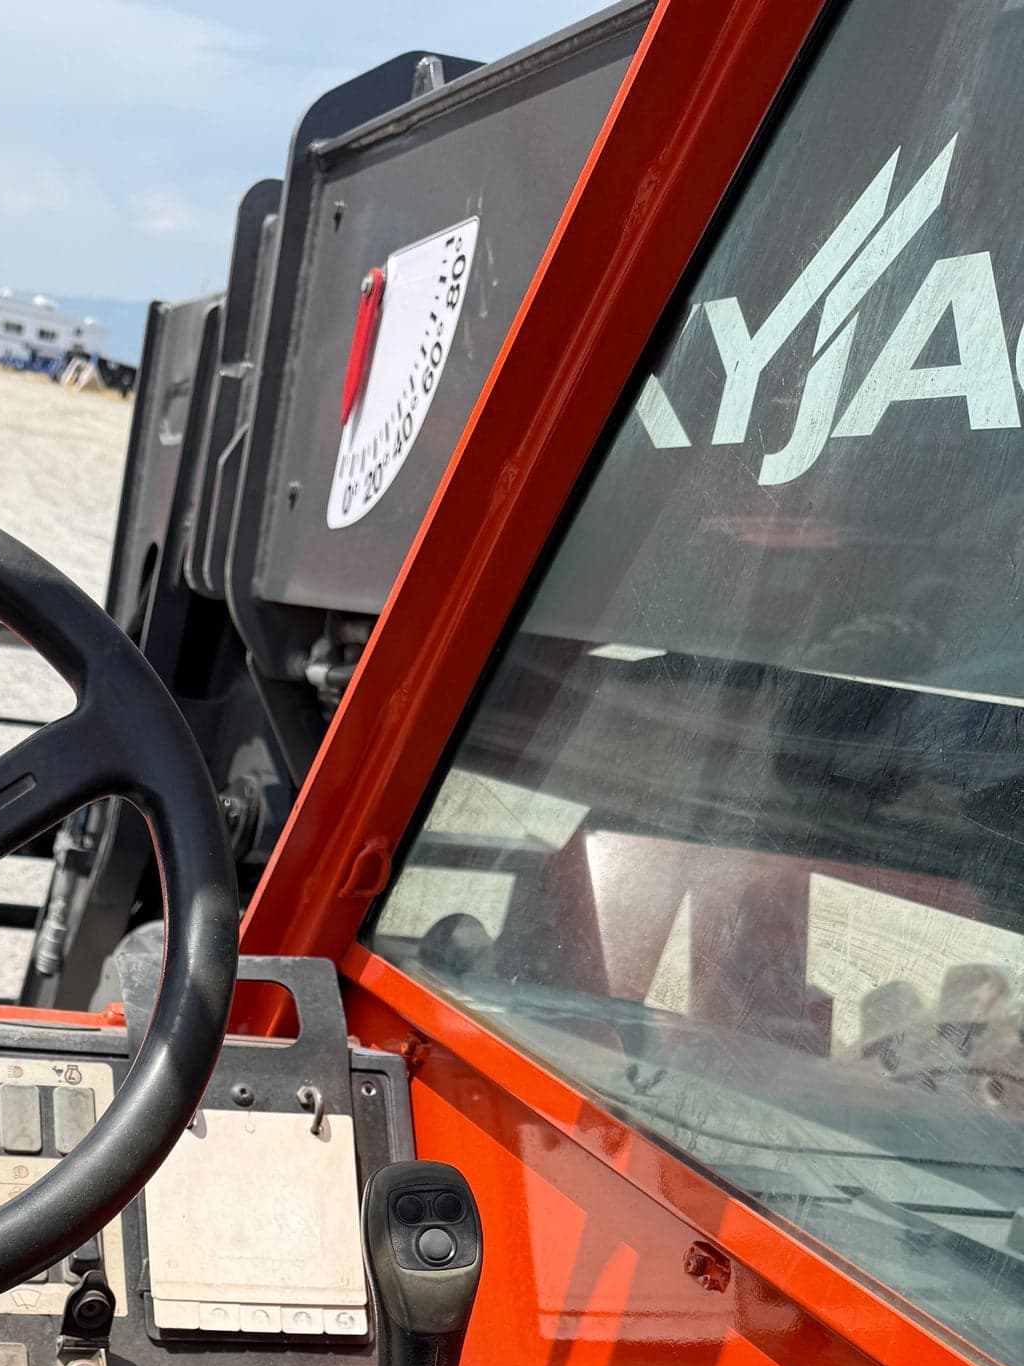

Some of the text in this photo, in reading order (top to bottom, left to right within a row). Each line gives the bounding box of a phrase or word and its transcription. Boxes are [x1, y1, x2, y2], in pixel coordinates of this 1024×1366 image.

[422, 321, 444, 394] 60°
[446, 236, 466, 311] 80°
[635, 132, 1024, 485] YJA
